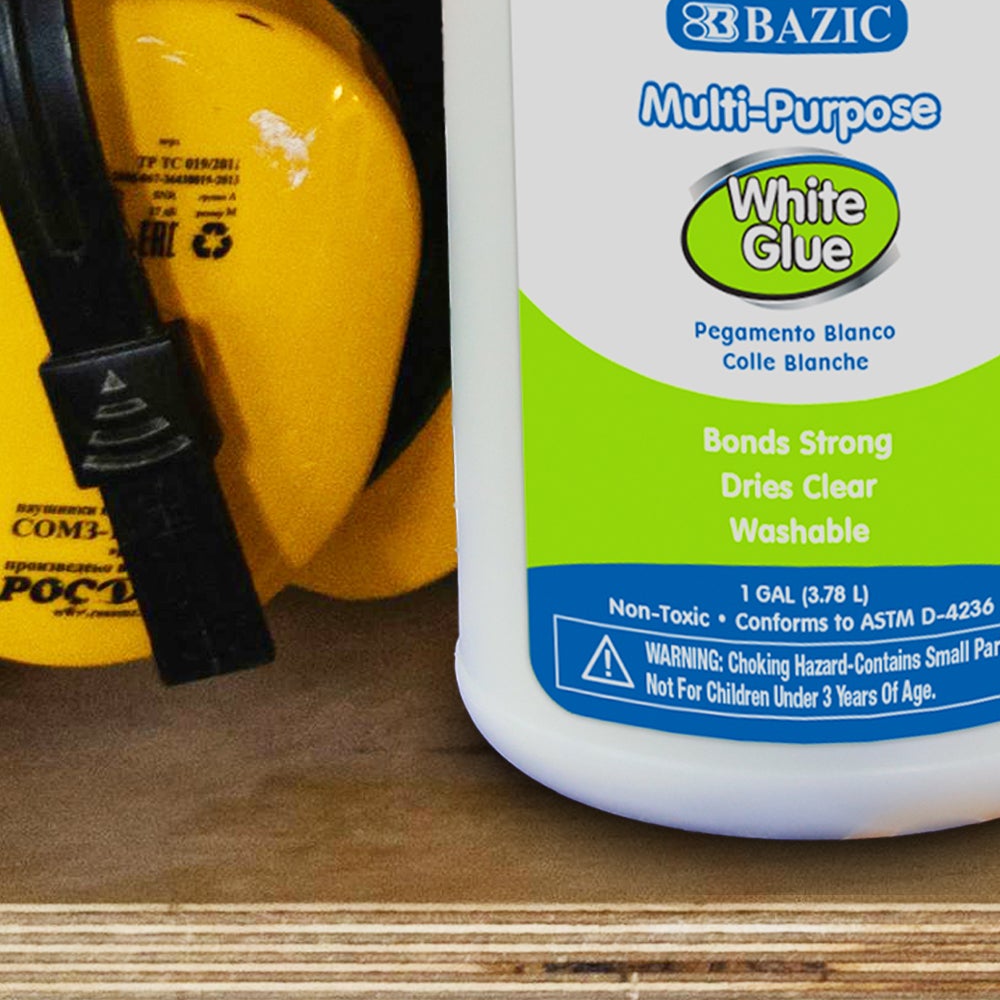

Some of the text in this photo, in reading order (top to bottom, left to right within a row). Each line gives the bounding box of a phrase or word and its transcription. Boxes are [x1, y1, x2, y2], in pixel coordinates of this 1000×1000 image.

[744, 5, 891, 44] BAZIC
[639, 80, 941, 144] Multi-Purpose
[727, 175, 866, 225] White
[741, 223, 853, 272] Glue
[695, 321, 896, 346] Pegamento Blanco
[723, 352, 869, 371] Colle Blanche
[703, 426, 893, 461] Bonds Strong
[721, 471, 878, 500] Dries Clear
[729, 516, 870, 545] Washable
[740, 584, 869, 609] 1 GAL (3.78 L)
[608, 597, 995, 633] Non-Toxic Conforms to ASTM D-4236
[644, 640, 723, 673] WARNING:
[727, 650, 790, 682] Choking
[794, 648, 921, 677] Hazard-Contains
[925, 639, 969, 669] Small
[645, 672, 937, 709] Not For Children Under 3 Years Of Age.
